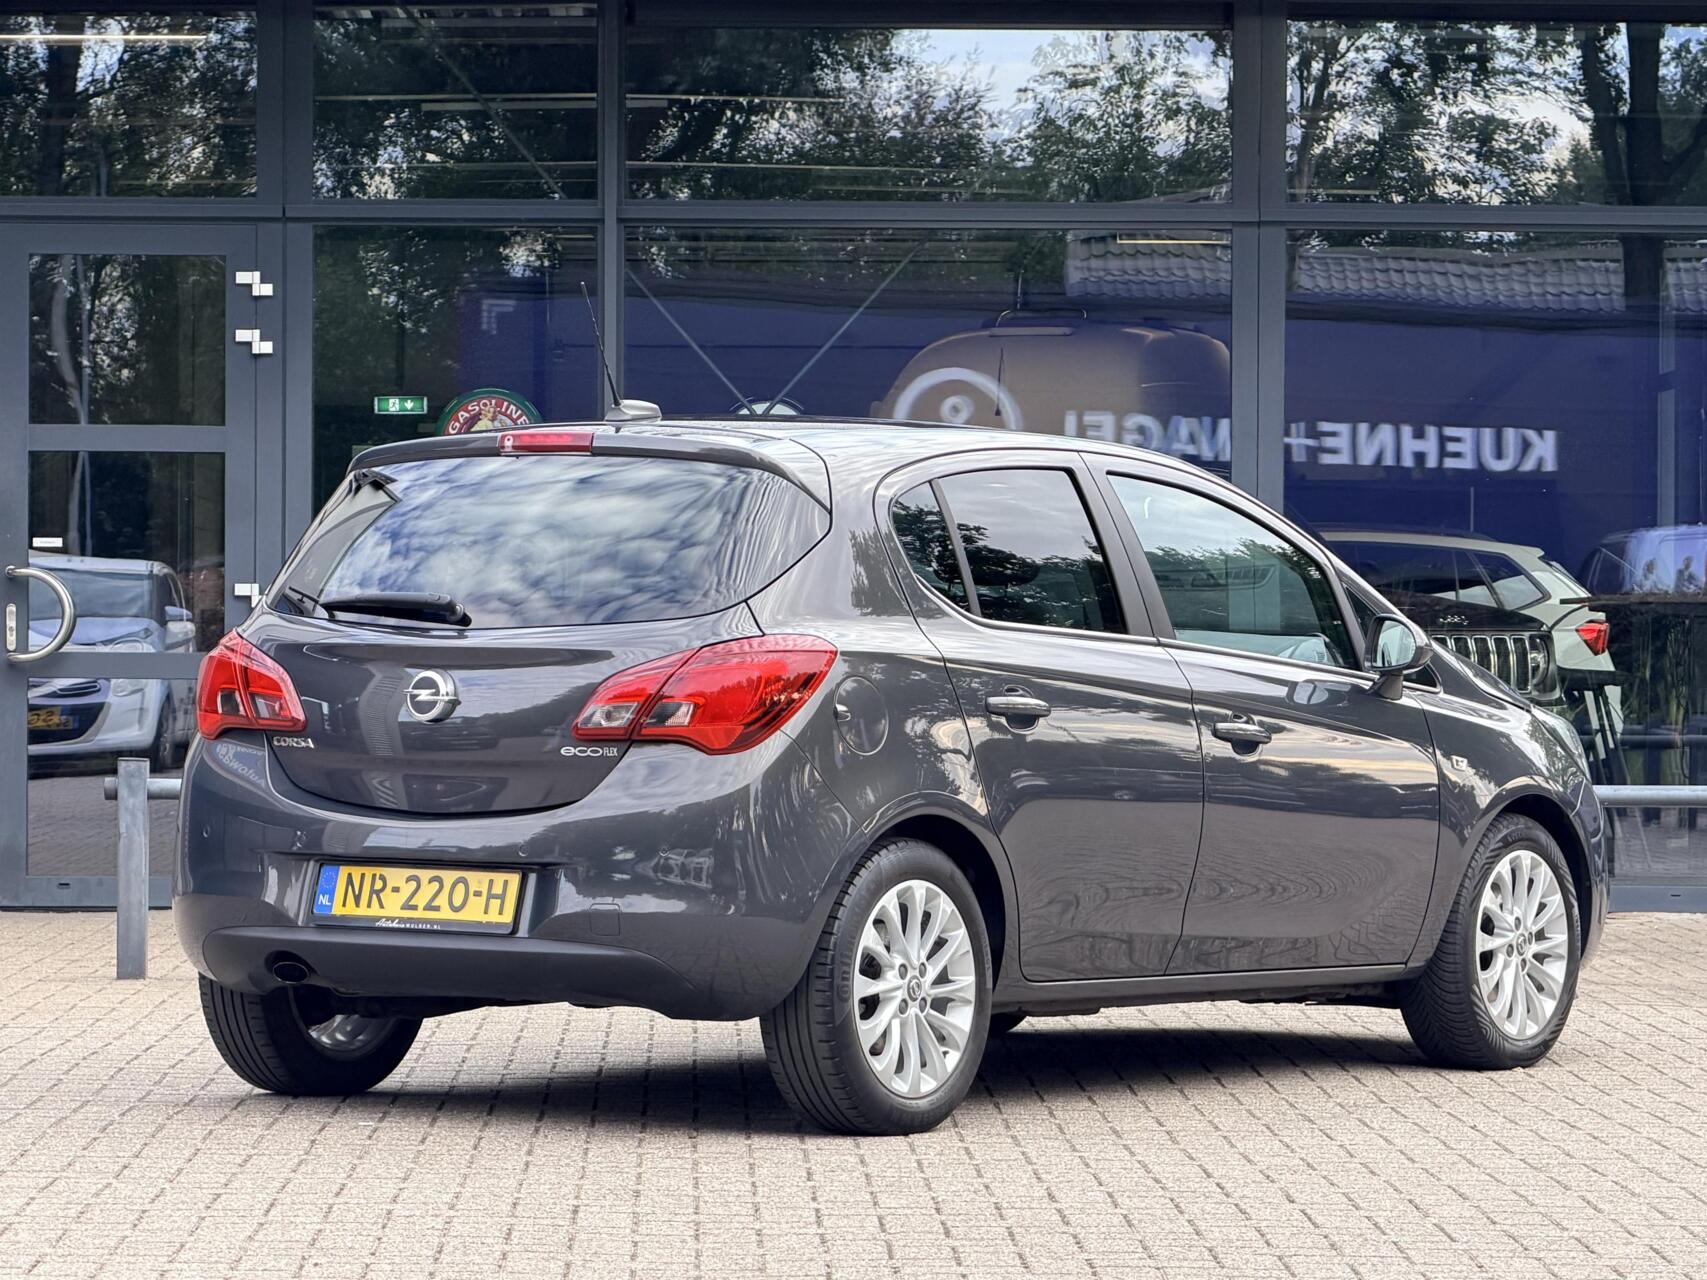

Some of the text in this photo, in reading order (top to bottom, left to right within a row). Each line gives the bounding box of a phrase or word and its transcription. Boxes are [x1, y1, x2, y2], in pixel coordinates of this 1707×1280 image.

[448, 399, 530, 434] GASOLINE
[273, 736, 315, 749] CORSA
[318, 894, 332, 906] NL
[341, 872, 509, 916] NR-220-H
